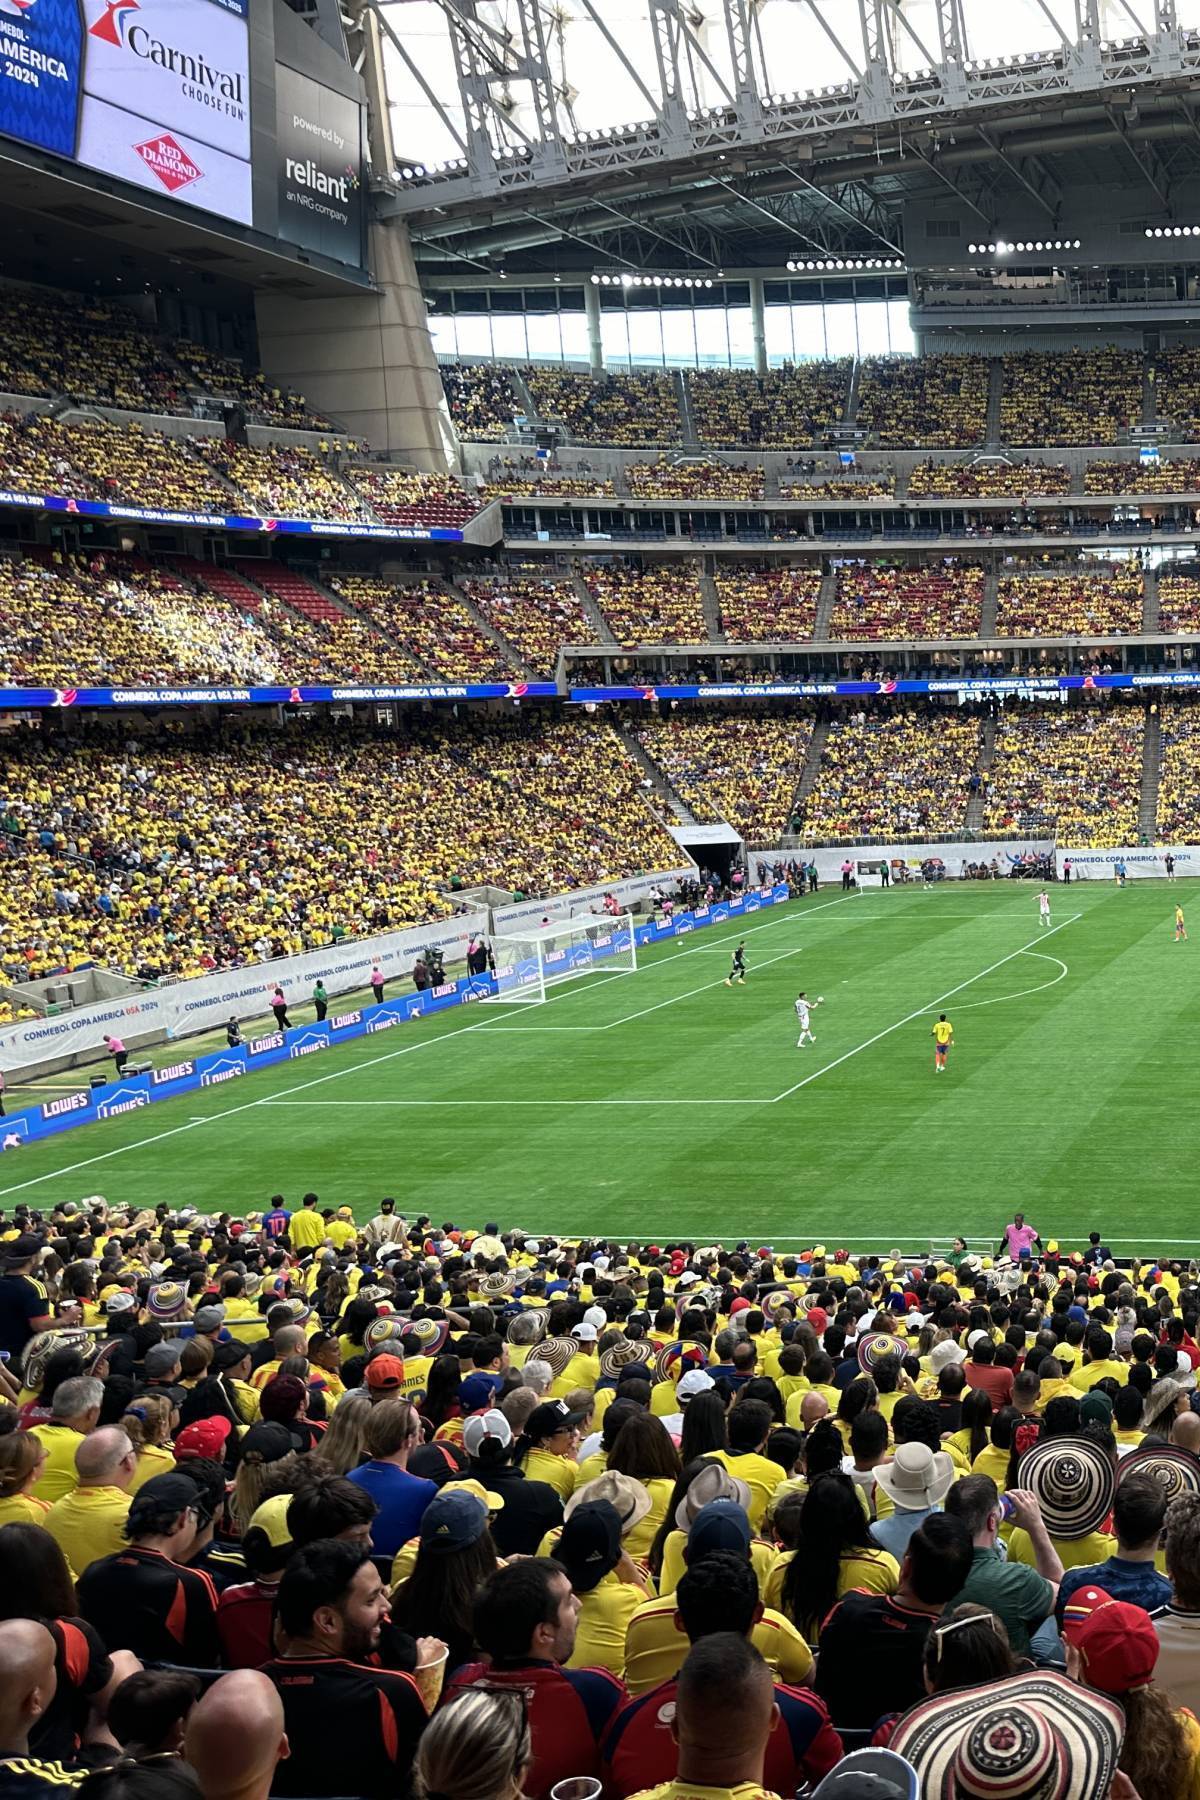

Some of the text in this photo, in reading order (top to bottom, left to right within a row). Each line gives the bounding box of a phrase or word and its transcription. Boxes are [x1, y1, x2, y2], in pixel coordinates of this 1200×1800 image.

[5, 61, 39, 88] 2024
[128, 26, 243, 104] Carnival
[182, 83, 244, 121] CHOOSE FUN
[293, 115, 345, 150] powered by
[143, 146, 197, 178] DIAMOND
[158, 140, 182, 161] RED
[286, 157, 348, 203] reliant
[286, 191, 348, 225] an NRG company
[112, 690, 250, 702] CONMEBOL COPA AMERICA USA 2024
[332, 687, 467, 698] CONMEBOL COPA AMERICA USA 2024
[698, 685, 837, 696] CONMEBOL COPA AMERICA USA 2024
[304, 968, 335, 982] CONMEBOL
[335, 963, 351, 974] COPA
[350, 959, 372, 970] AMERICA
[184, 995, 222, 1011] CONMEBOL
[222, 991, 239, 1002] COPA
[239, 985, 267, 998] AMERICA
[431, 982, 457, 998] LOWE'S
[23, 1001, 159, 1042] CONMEBOL COPA AMERICA USA 2024
[331, 1011, 361, 1029] LOWE'S
[250, 1033, 283, 1055] LOWE'S
[153, 1060, 193, 1084] LOWE'S
[43, 1092, 88, 1118] LOWE'S
[268, 1216, 286, 1237] 10
[398, 1376, 426, 1389] AMES
